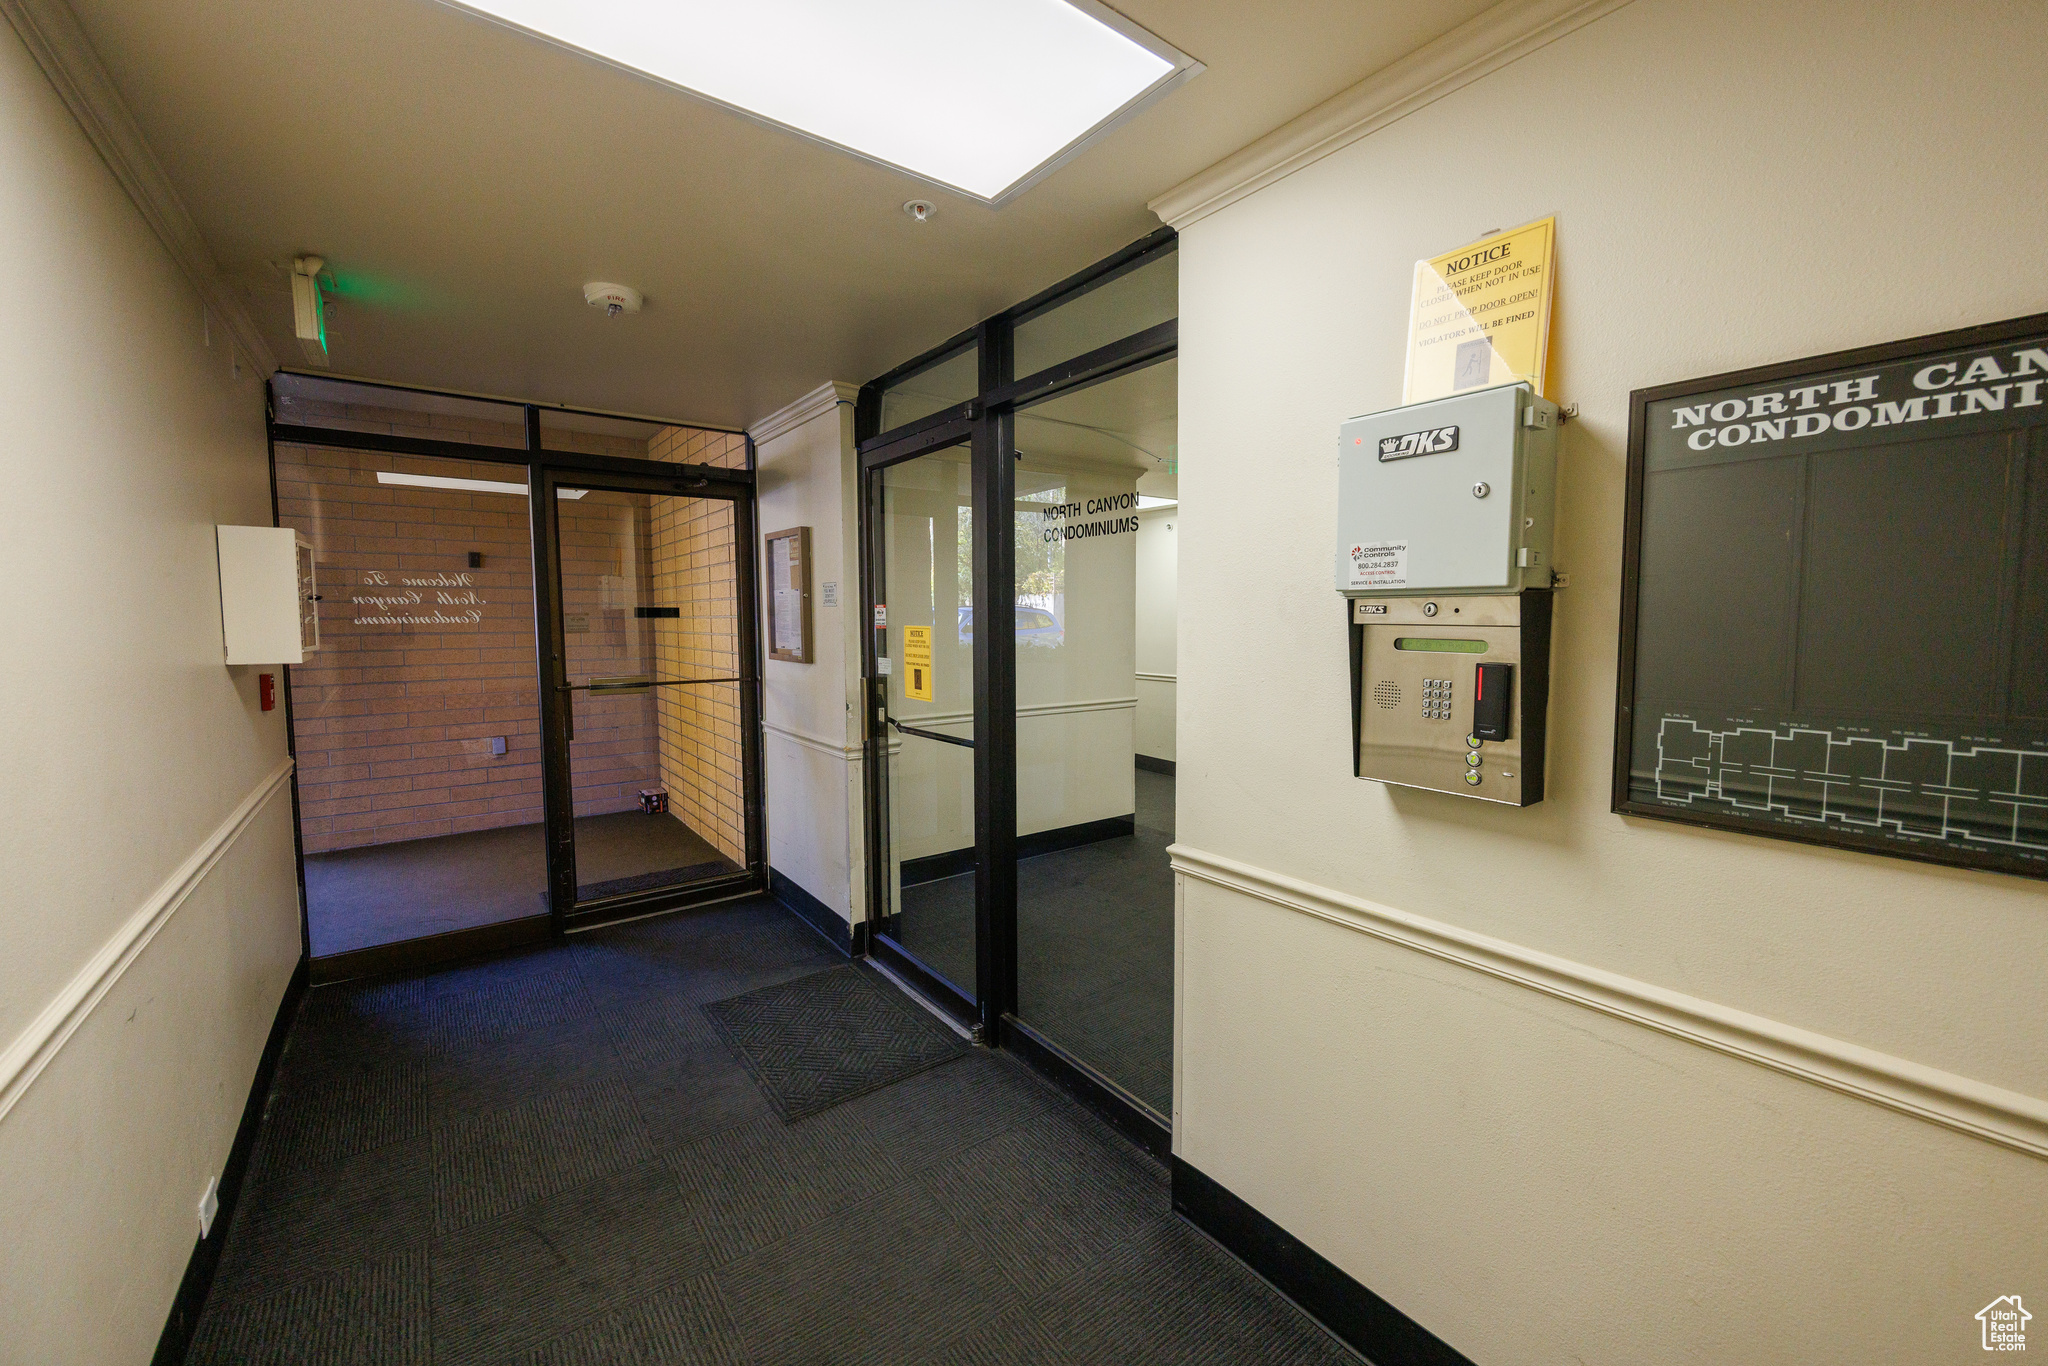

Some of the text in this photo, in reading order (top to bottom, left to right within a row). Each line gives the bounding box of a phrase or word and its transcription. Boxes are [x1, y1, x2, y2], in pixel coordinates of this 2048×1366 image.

[1446, 243, 1510, 276] NOTICE
[1420, 264, 1541, 308] CLOSED WHEN NOT IN USE
[1436, 260, 1522, 294] PLEASE KEEP DOOR
[1419, 289, 1538, 329] DO NOT PROP DOOR OPEN!
[1418, 329, 1466, 348] VIOLATORS
[1468, 323, 1490, 333] WILL
[1492, 319, 1503, 328] BE
[1506, 310, 1535, 324] FINED
[1672, 375, 1880, 429] NORTH
[1687, 376, 2048, 450] CONDOMINI
[1399, 427, 1456, 455] DKS
[1044, 492, 1139, 521] NORTH CANYON
[1044, 516, 1139, 542] CONDOMINIUMS
[1358, 561, 1398, 569] 800.284.2837
